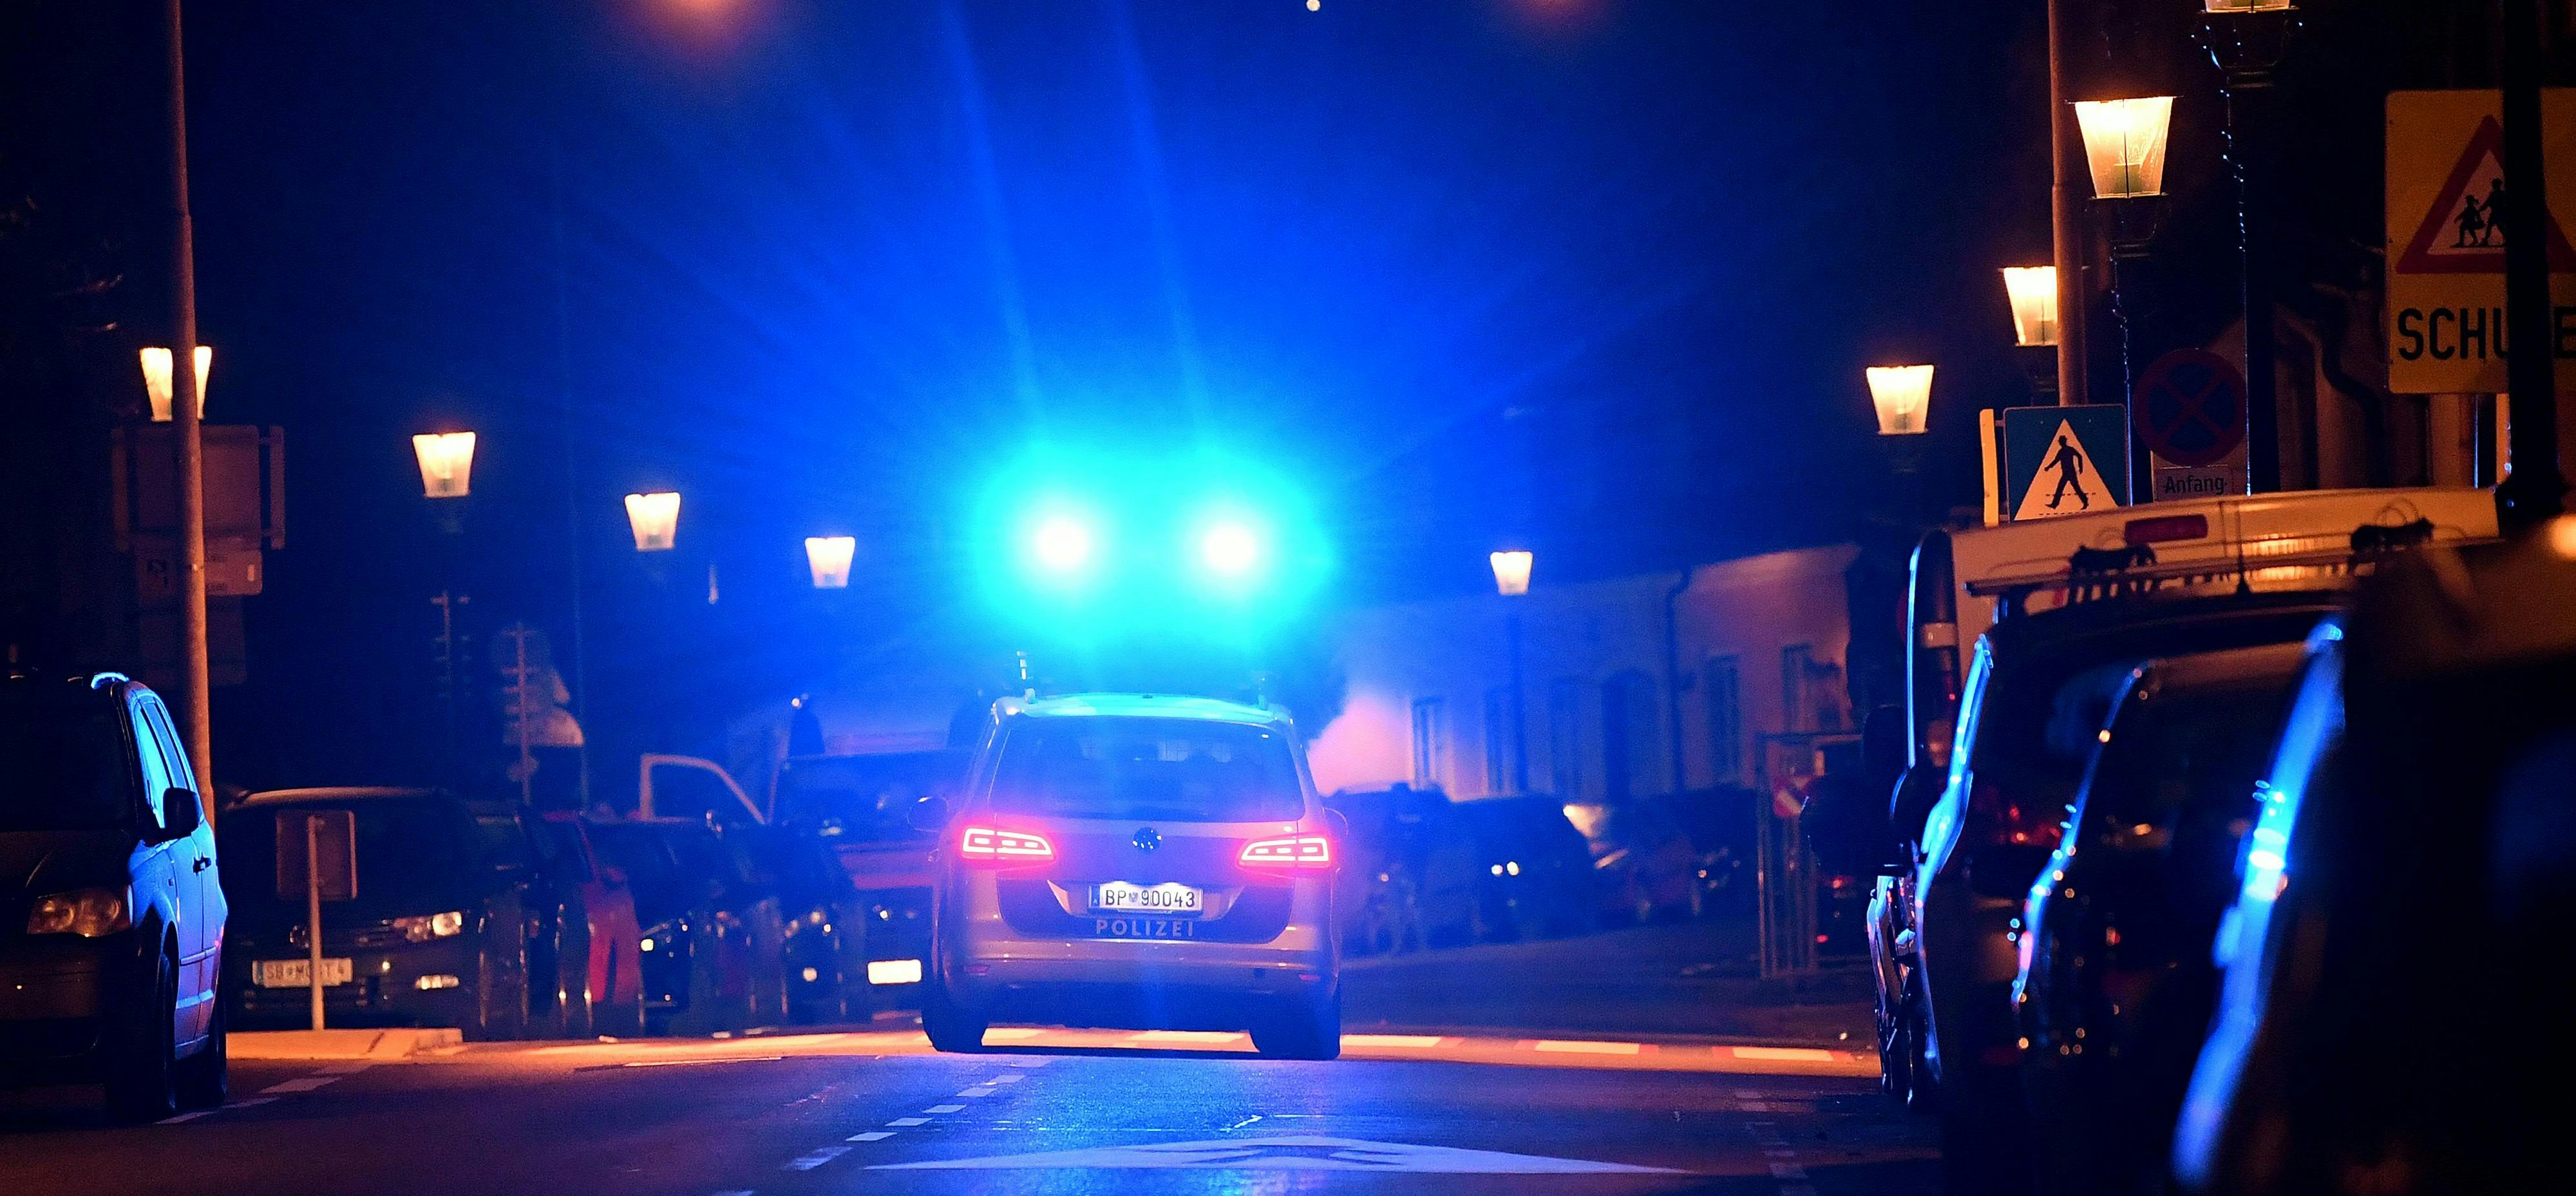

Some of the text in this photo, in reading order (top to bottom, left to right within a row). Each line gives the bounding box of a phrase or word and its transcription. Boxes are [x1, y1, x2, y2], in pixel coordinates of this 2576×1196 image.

[2398, 308, 2576, 361] SCHUE
[2165, 475, 2225, 495] Anfang
[1105, 889, 1195, 907] BP 90043
[1096, 920, 1193, 936] POLIZEI
